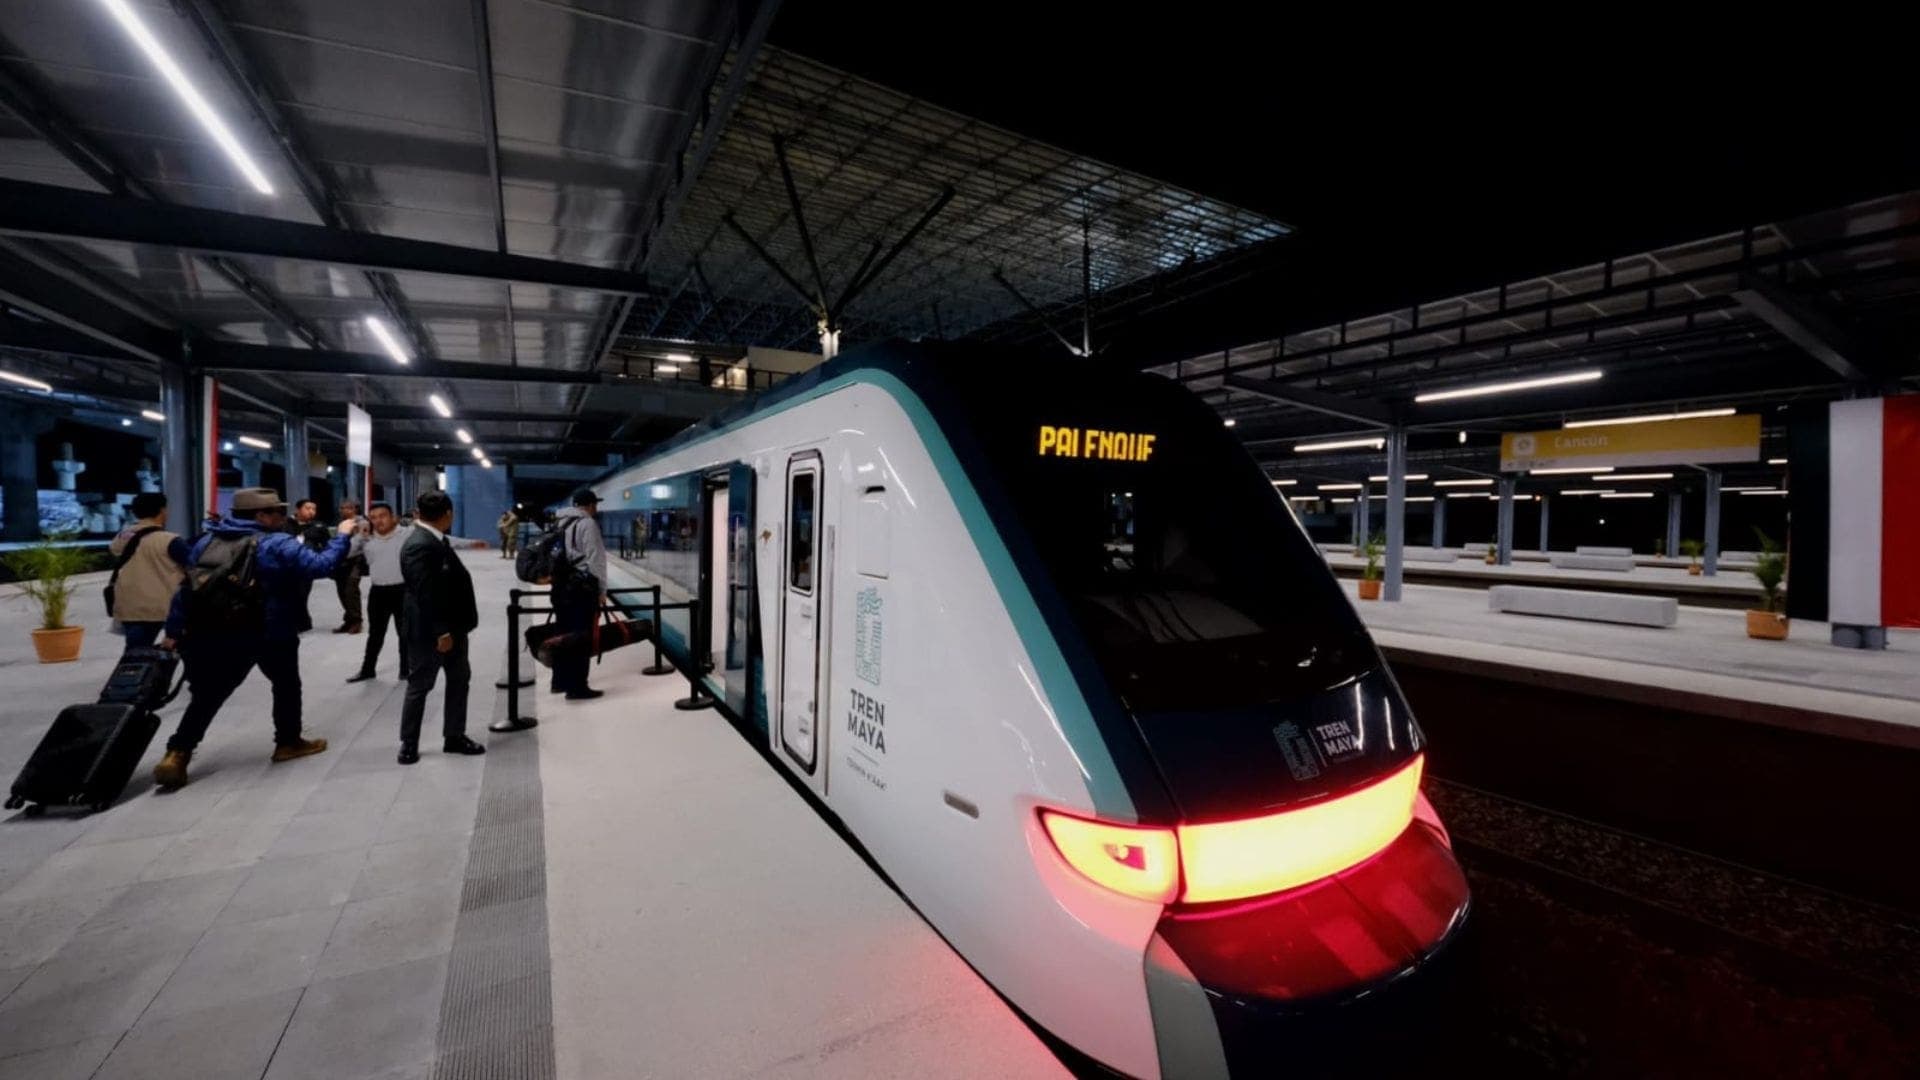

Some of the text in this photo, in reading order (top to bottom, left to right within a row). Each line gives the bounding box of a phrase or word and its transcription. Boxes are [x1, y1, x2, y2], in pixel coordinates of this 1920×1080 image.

[850, 688, 885, 726] TREN
[847, 711, 886, 754] MAYA
[1316, 720, 1351, 740] TREN
